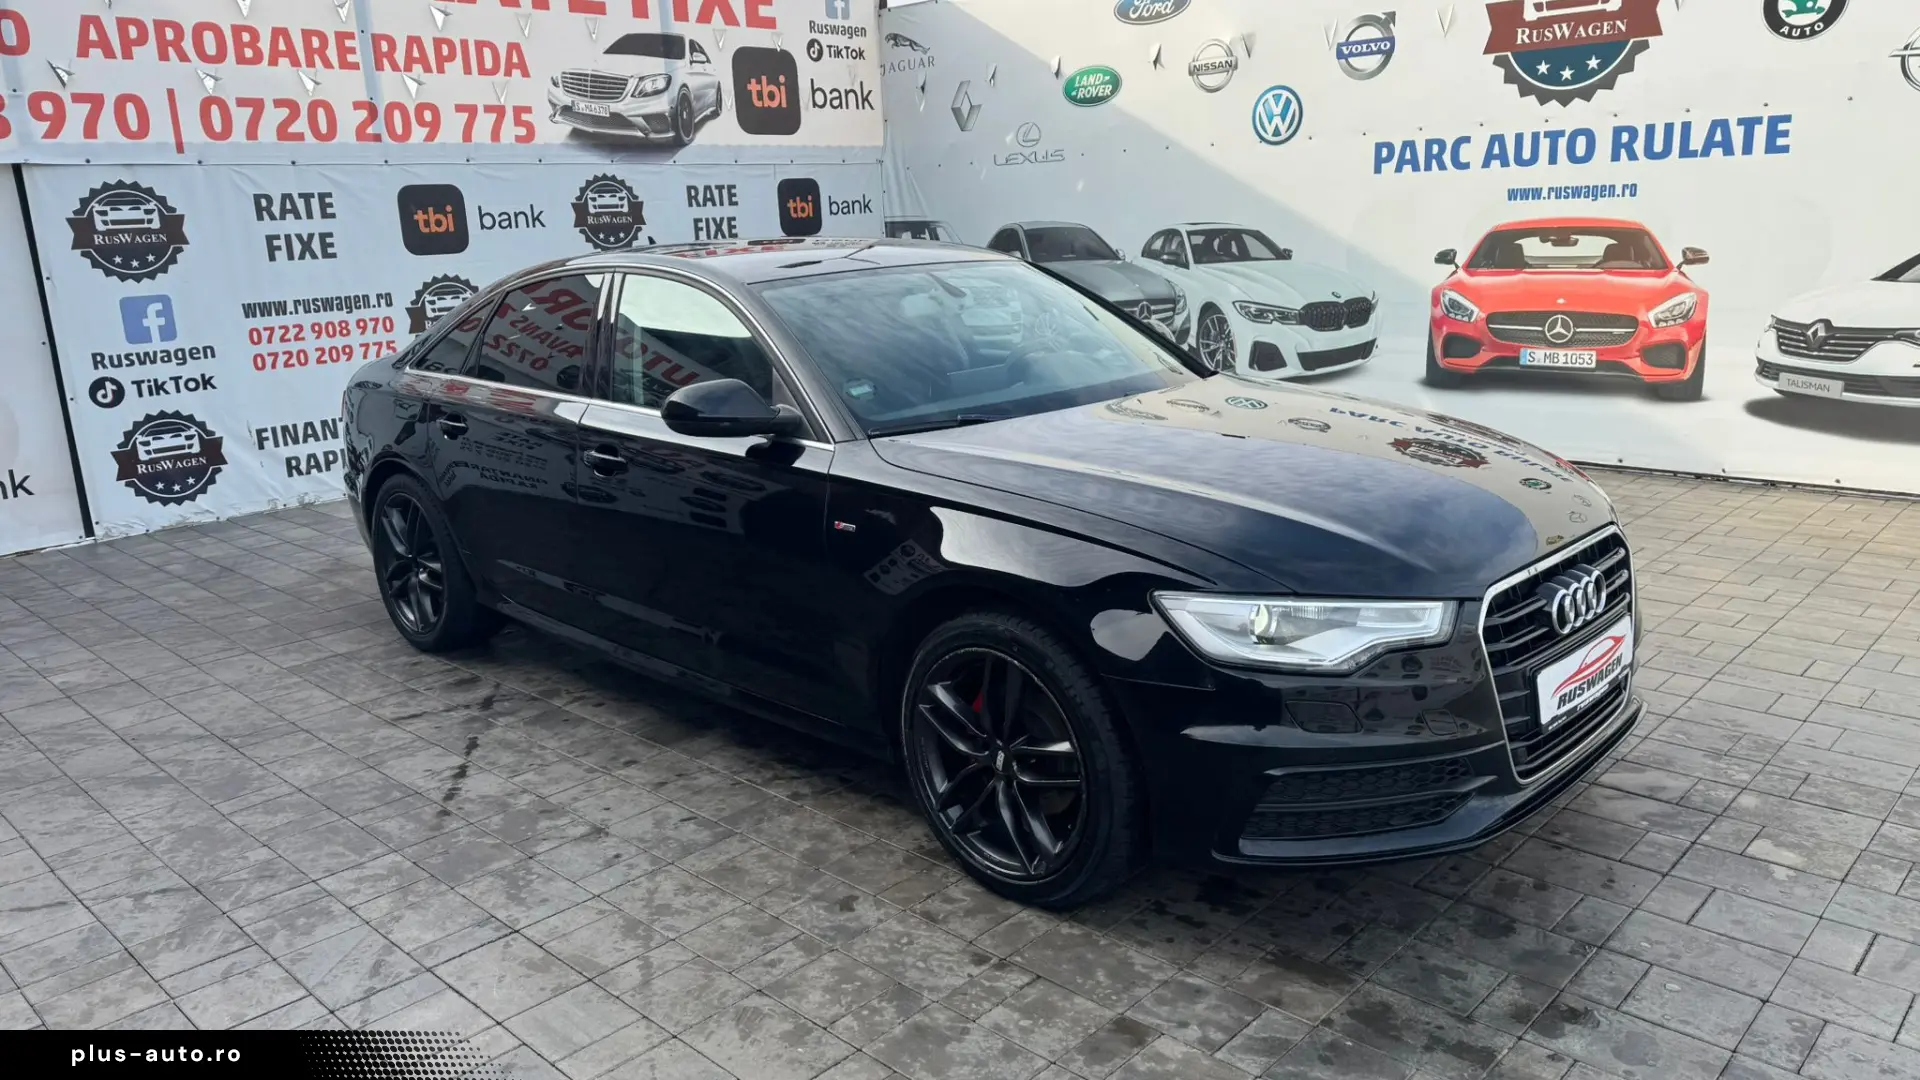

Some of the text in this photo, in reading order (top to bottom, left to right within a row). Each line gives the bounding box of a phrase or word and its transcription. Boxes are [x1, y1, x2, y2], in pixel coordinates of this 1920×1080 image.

[1129, 0, 1175, 19] Ford
[809, 20, 867, 39] Ruswagen
[1780, 22, 1824, 36] AUTO
[76, 14, 361, 71] APROBARE
[370, 32, 531, 79] RAPIDA
[826, 45, 866, 60] TikTok
[1341, 40, 1391, 54] VOLVO
[880, 55, 935, 77] JAGUAR
[1192, 59, 1233, 73] NISSAN
[1075, 73, 1103, 87] LAND
[1077, 84, 1113, 99] ROVER
[747, 75, 875, 110] tbi bank
[27, 91, 151, 140] 970
[199, 95, 338, 142] 0720
[353, 100, 442, 143] 209
[454, 104, 536, 144] 775
[1374, 114, 1792, 174] PARC AUTO RULATE
[994, 149, 1065, 166] LEXUS
[686, 184, 739, 208] RATE
[1507, 182, 1638, 202] www.ruswagen.ro
[253, 192, 337, 222] RATE
[413, 203, 546, 234] tbi bank
[787, 194, 873, 219] tbi bank
[693, 217, 738, 240] FIXE
[265, 232, 338, 263] FIXE
[241, 292, 394, 319] www.ruswagen.ro
[248, 316, 395, 346] 0722 908 970
[91, 344, 217, 371] Ruswagen
[252, 340, 397, 372] 0720 209 775
[1528, 351, 1536, 363] S
[1562, 352, 1594, 366] 1053
[131, 373, 218, 398] TikTok
[1787, 378, 1831, 393] TALISMAN
[255, 416, 343, 451] FINAN
[1557, 653, 1623, 710] RUSWAGEN
